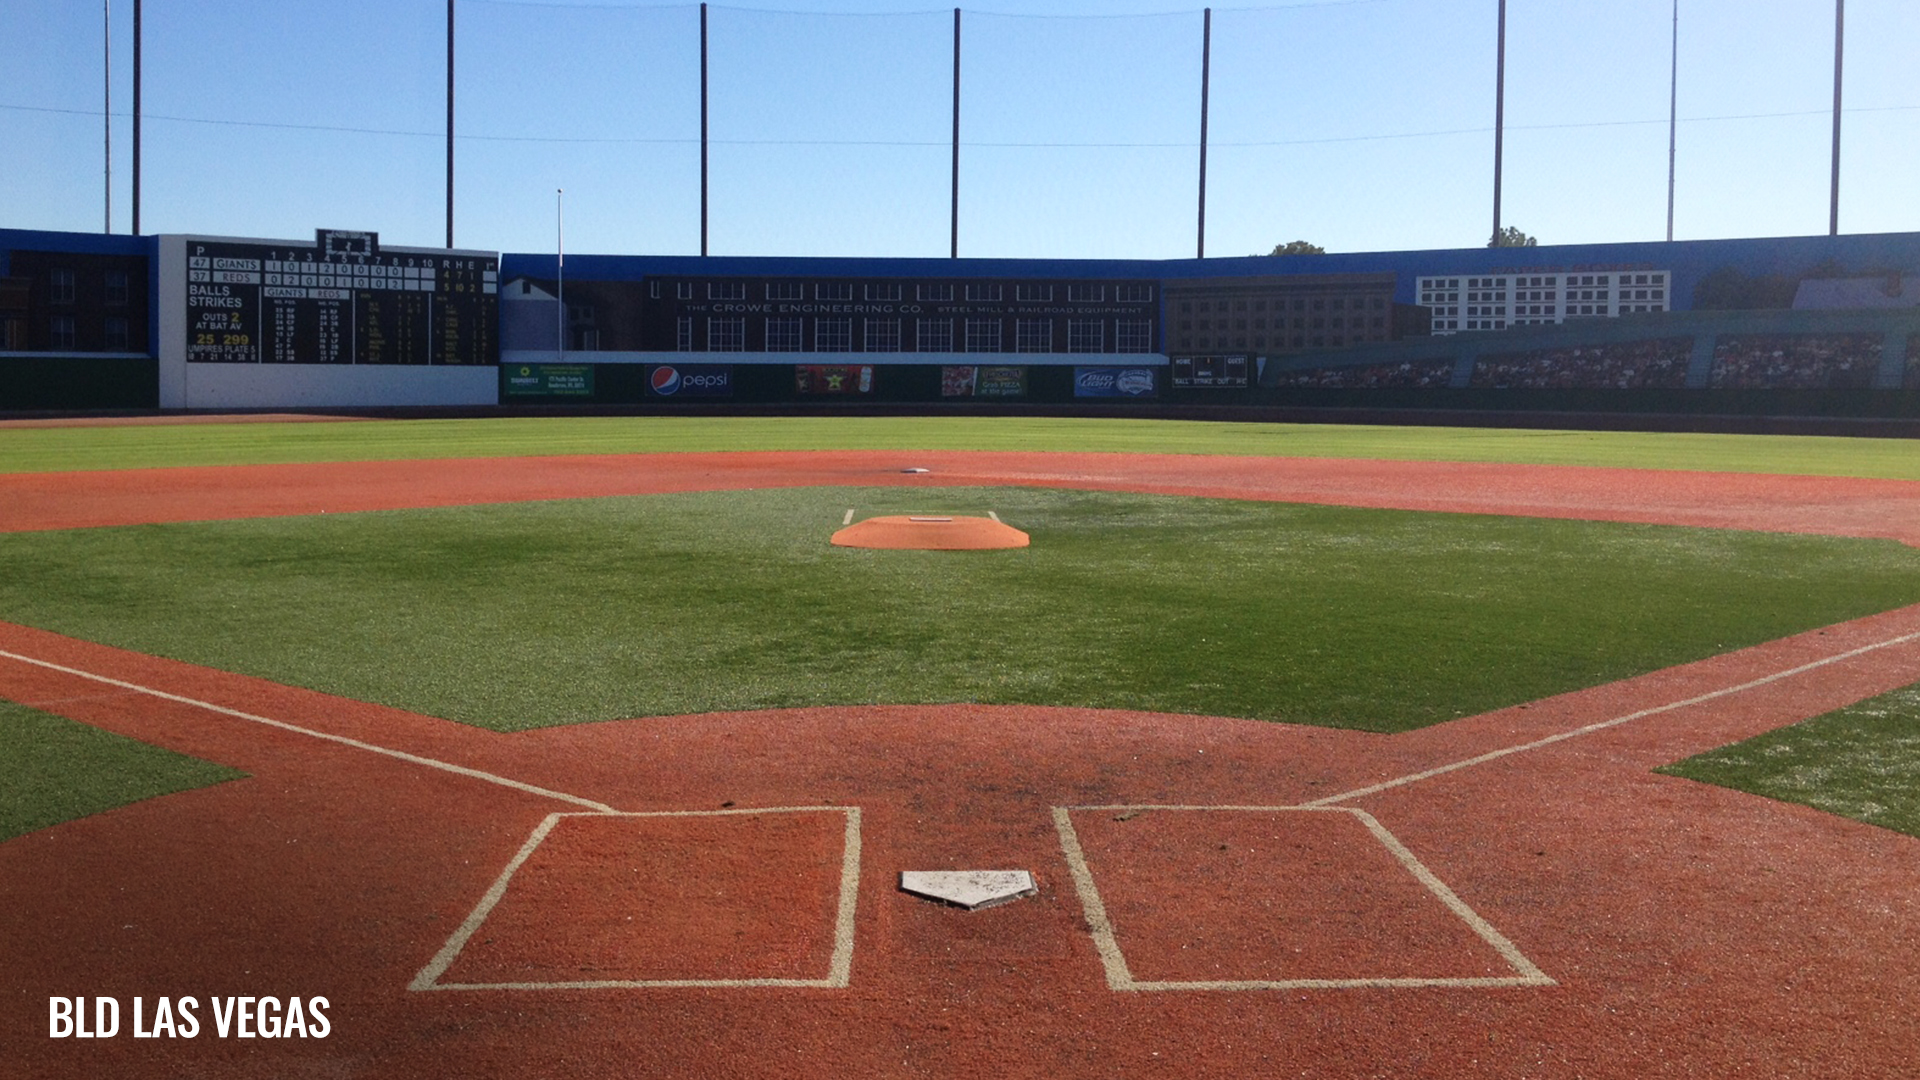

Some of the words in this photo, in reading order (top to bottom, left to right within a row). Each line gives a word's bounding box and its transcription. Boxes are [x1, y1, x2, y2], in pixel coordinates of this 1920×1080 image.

[196, 246, 205, 256] P
[271, 251, 276, 260] 1
[289, 252, 295, 261] 2
[307, 253, 313, 261] 3
[342, 254, 348, 263] 5
[358, 255, 364, 264] 6
[393, 258, 399, 266] 8
[408, 259, 414, 267] 9
[422, 259, 433, 267] 10
[193, 259, 206, 267] 47
[216, 259, 257, 270] GIANTS
[288, 263, 295, 271] 0
[324, 264, 330, 272] 2
[342, 265, 348, 273] 0
[358, 266, 364, 274] 0
[376, 266, 382, 274] 0
[392, 267, 399, 276] 0
[443, 260, 450, 269] R
[456, 261, 463, 269] H
[468, 262, 475, 270] E
[193, 272, 206, 281] 37
[222, 273, 251, 282] REDS
[271, 275, 277, 284] 0
[289, 276, 295, 284] 2
[306, 277, 313, 285] 0
[324, 277, 331, 286] 0
[358, 279, 364, 287] 0
[375, 279, 382, 288] 0
[393, 280, 399, 289] 2
[444, 283, 450, 291] 5
[455, 283, 464, 292] 10
[469, 284, 476, 292] 2
[190, 285, 230, 296] BALLS
[267, 288, 304, 297] GIANTS
[317, 290, 341, 298] REDS
[189, 296, 243, 308] STRIKES
[712, 303, 773, 312] CROWE
[779, 304, 895, 313] ENGINEERING
[899, 304, 924, 313] CO.
[1018, 306, 1074, 314] RAILROAD
[203, 313, 228, 321] OUTS
[231, 312, 240, 322] 2
[210, 322, 228, 330] BAT
[197, 333, 215, 345] 25
[223, 334, 249, 345] 299
[188, 344, 223, 353] UMPIRES
[224, 345, 249, 354] PLATE
[1227, 357, 1245, 365] GUEST
[683, 372, 727, 388] pepsi
